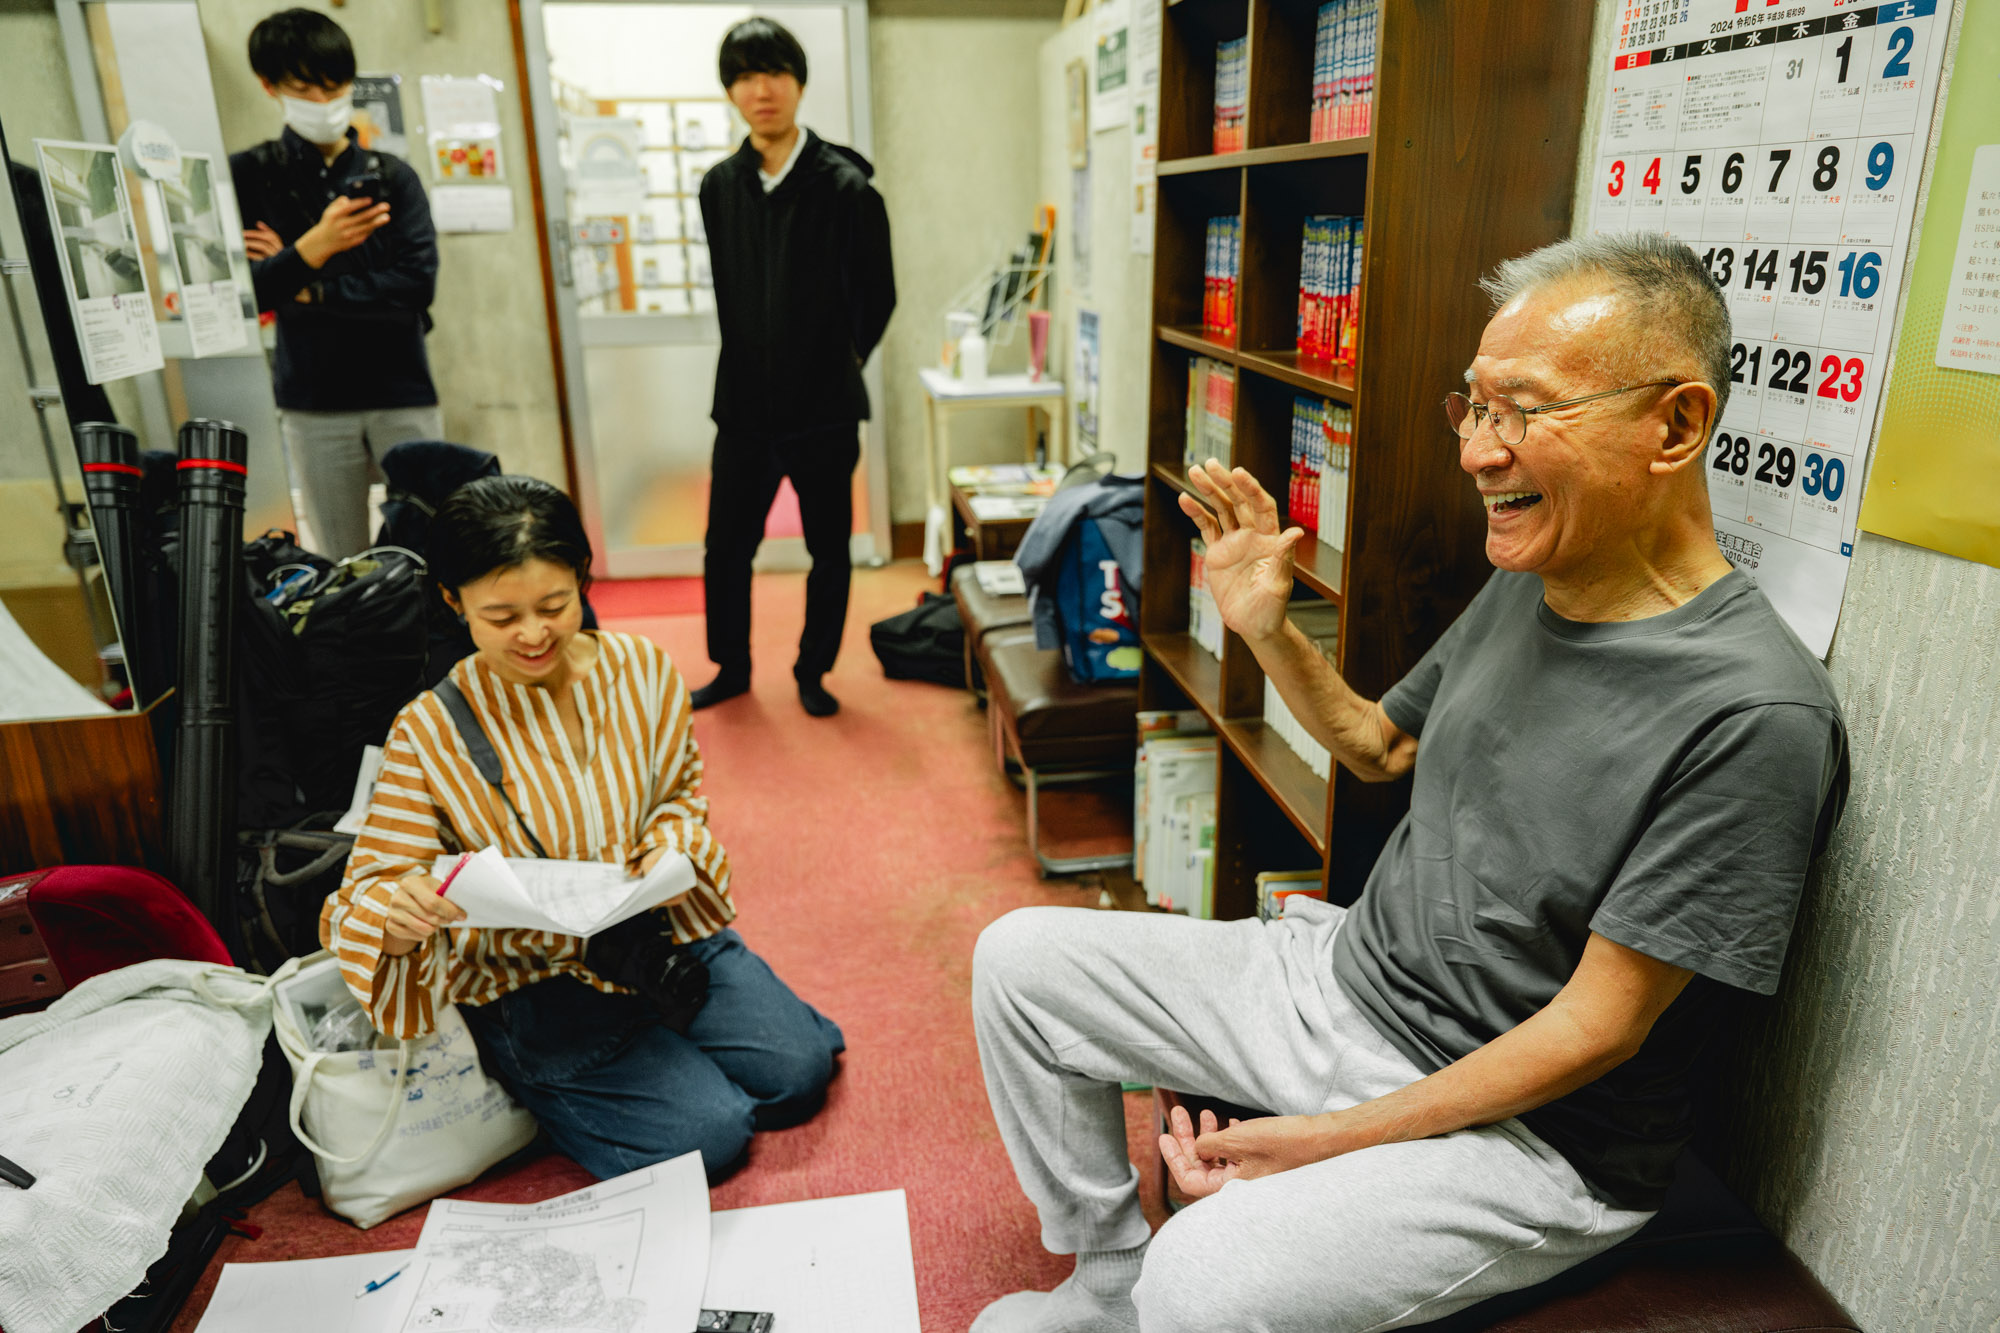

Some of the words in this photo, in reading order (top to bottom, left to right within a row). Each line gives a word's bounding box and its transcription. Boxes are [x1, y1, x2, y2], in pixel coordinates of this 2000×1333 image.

[1630, 22, 1638, 33] 21
[1640, 20, 1648, 31] 22
[1649, 17, 1657, 29] 23
[1659, 15, 1667, 27] 24
[1669, 12, 1677, 25] 25
[1679, 10, 1688, 23] 26
[1709, 19, 1734, 34] 2024
[1736, 13, 1765, 29] 令和6年
[1766, 10, 1785, 22] 平成36
[1786, 6, 1806, 18] 昭和99
[1627, 54, 1638, 68] 日
[1662, 46, 1676, 62] 月
[1701, 39, 1717, 55] 火
[1744, 31, 1762, 47] 水
[1792, 22, 1810, 38] 木
[1842, 12, 1861, 31] 金
[1894, 1, 1915, 21] 土
[1637, 33, 1646, 46] 29
[1647, 31, 1655, 44] 30
[1657, 29, 1665, 42] 31
[1785, 58, 1804, 80] 31
[1836, 35, 1853, 84] 1
[1882, 26, 1914, 79] 2
[1902, 80, 1916, 89] 大安
[1608, 160, 1625, 197] 3
[1642, 157, 1661, 195] 4
[1680, 155, 1702, 195] 5
[1721, 152, 1745, 194] 6
[1768, 149, 1791, 193] 7
[1812, 145, 1840, 192] 8
[1865, 141, 1895, 191] 9
[1829, 195, 1841, 204] 大安
[1702, 247, 1735, 288] 13
[1743, 249, 1779, 291] 14
[1789, 250, 1829, 295] 15
[1838, 251, 1882, 299] 16
[1760, 295, 1772, 303] 大安
[1860, 303, 1874, 312] 先勝
[1731, 343, 1762, 386] 21
[1768, 348, 1811, 394] 22
[1816, 354, 1865, 403] 23
[1793, 397, 1805, 406] 先勝
[1843, 406, 1856, 415] 友引
[1712, 432, 1751, 476] 28
[1754, 442, 1796, 488] 29
[1802, 453, 1845, 502] 30
[1778, 490, 1790, 500] 友引
[1826, 504, 1838, 514] 先負
[1842, 546, 1850, 554] 11
